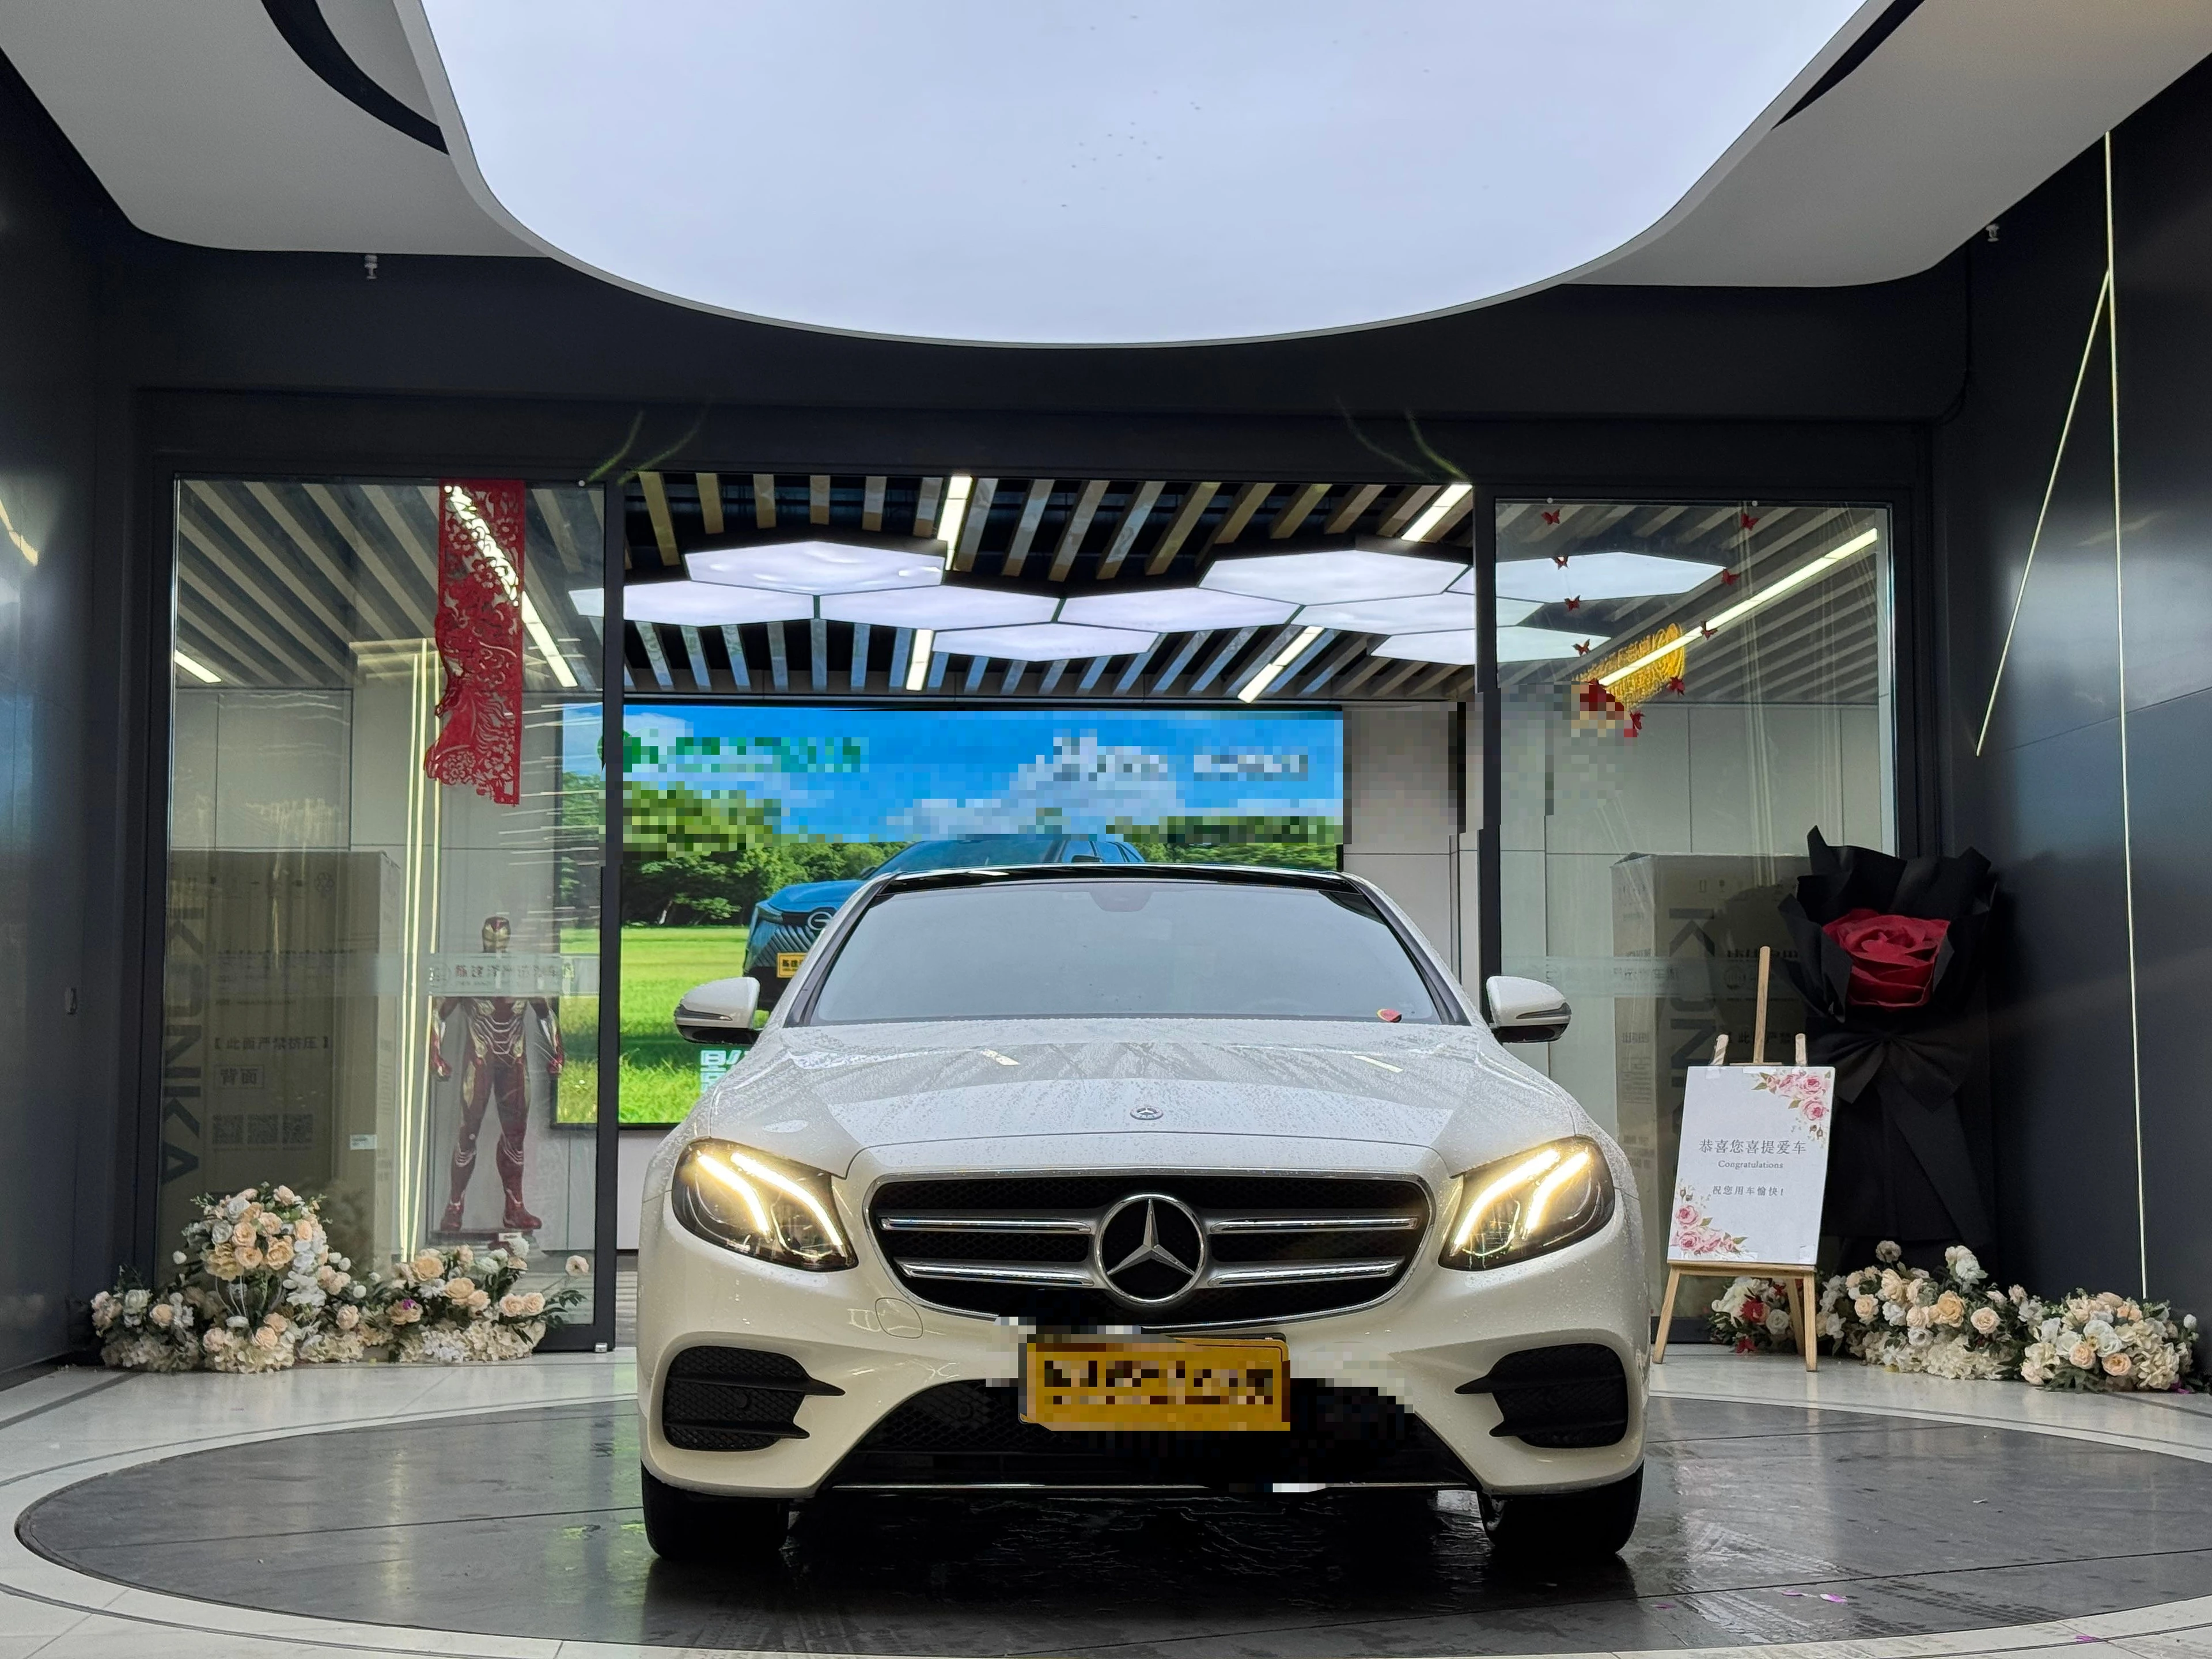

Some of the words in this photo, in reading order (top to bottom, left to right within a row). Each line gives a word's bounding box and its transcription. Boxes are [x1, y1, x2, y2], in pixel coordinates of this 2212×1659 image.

[1699, 1138, 1807, 1154] 恭喜您喜提爱车
[1717, 1160, 1784, 1170] Congratulations
